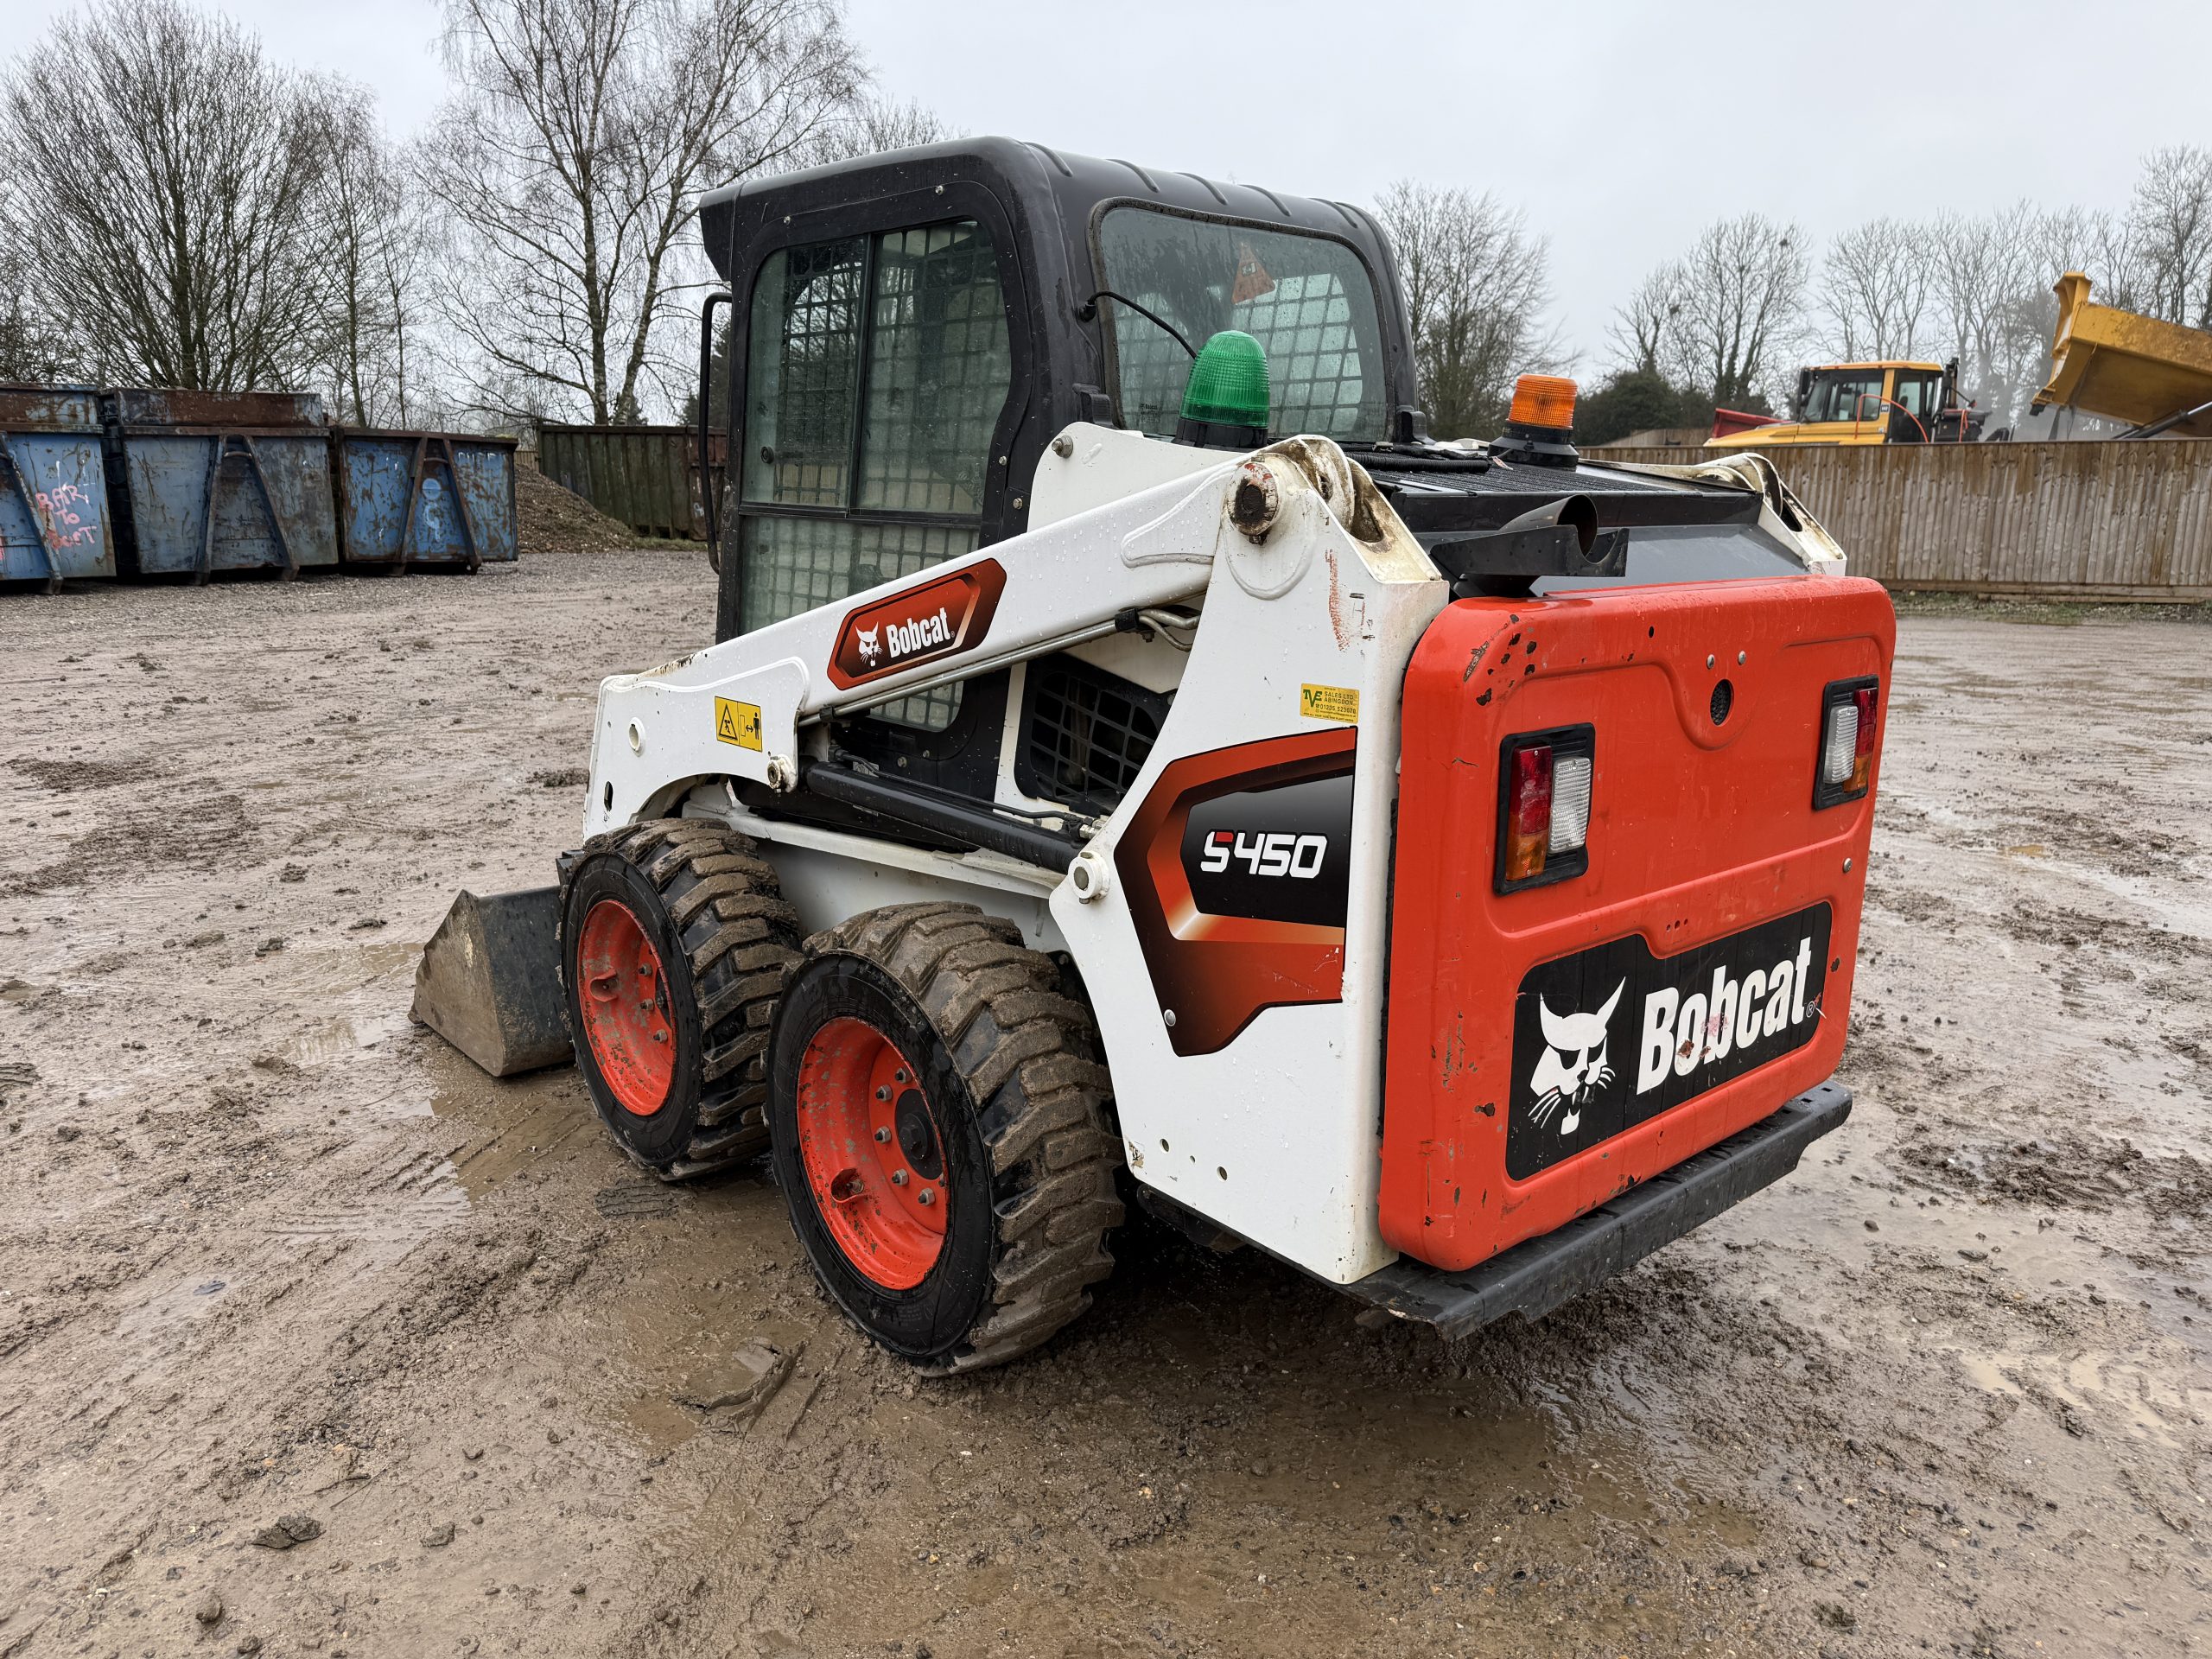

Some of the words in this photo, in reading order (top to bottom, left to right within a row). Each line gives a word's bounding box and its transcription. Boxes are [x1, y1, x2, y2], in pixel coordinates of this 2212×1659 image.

[886, 607, 951, 658] Bobcat
[1324, 690, 1342, 699] SALES
[1324, 697, 1354, 706] ABINGDON
[1200, 830, 1328, 879] S450
[1637, 937, 1812, 1096] Bobcat
